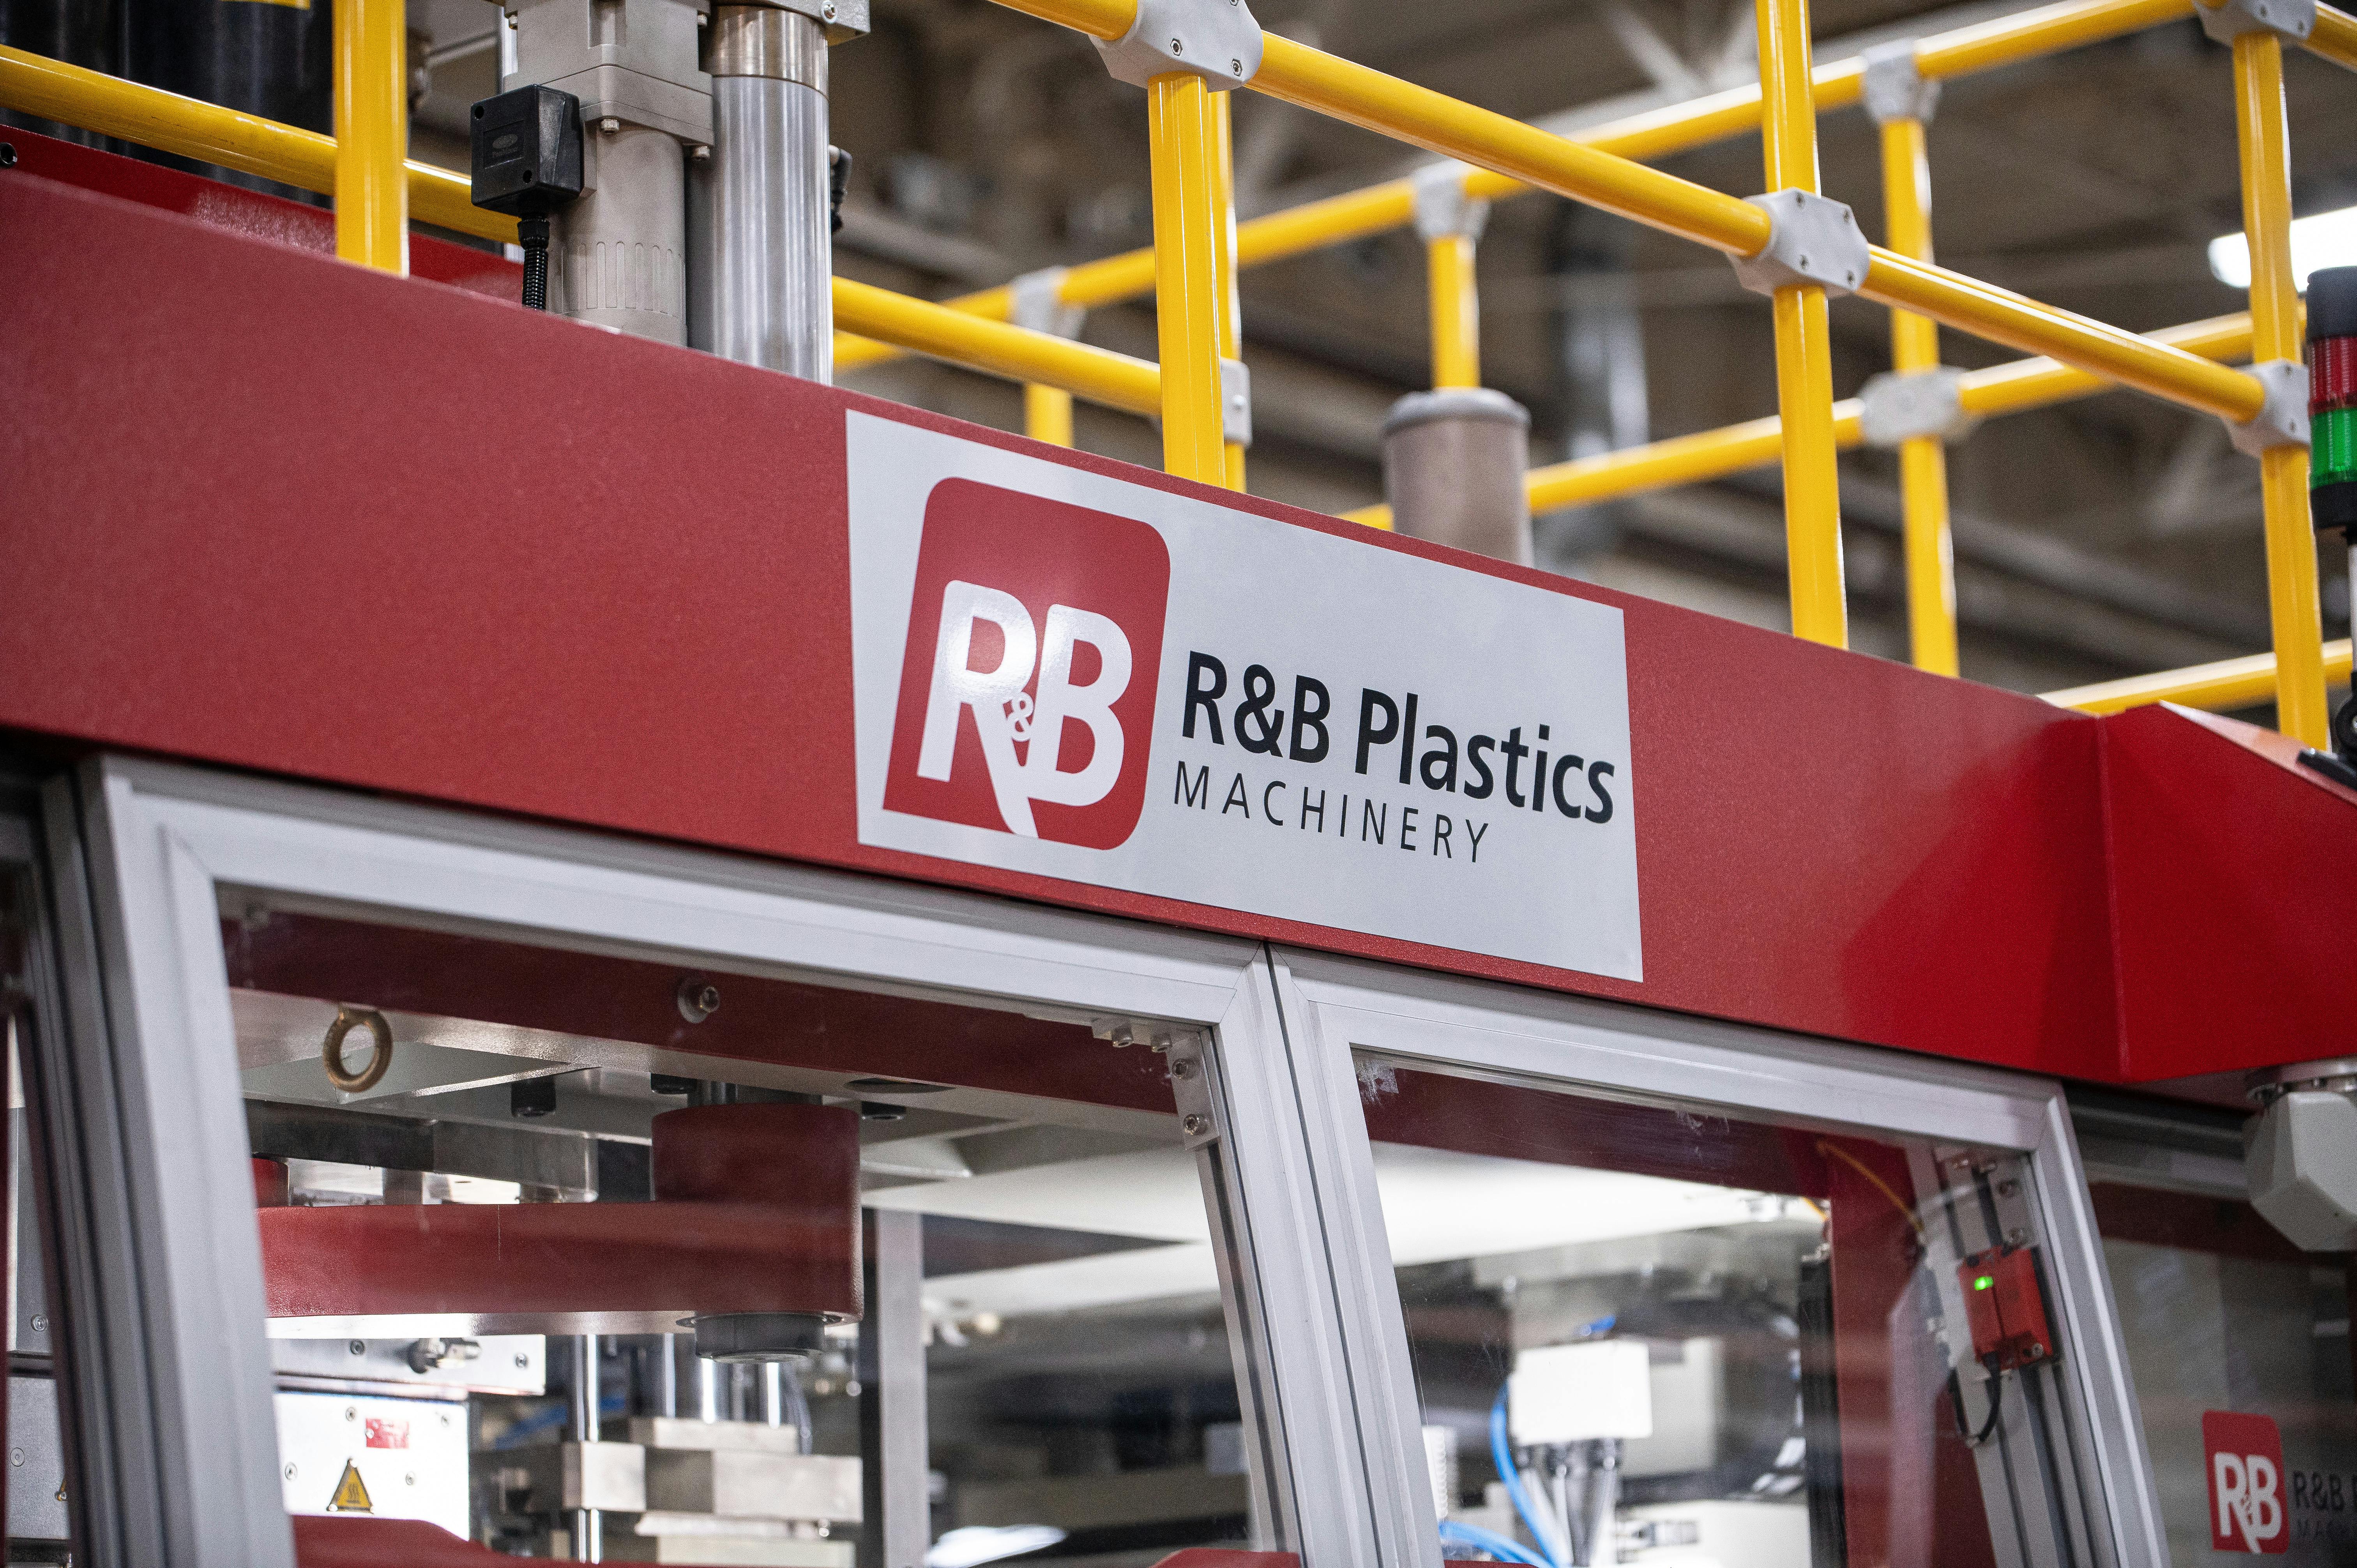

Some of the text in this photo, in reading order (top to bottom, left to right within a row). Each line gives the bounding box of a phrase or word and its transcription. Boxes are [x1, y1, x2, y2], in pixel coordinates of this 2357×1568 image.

[917, 579, 1133, 838] R&B
[1182, 651, 1614, 824] R&B Plastics
[1174, 761, 1488, 862] MACHINERY
[2293, 1470, 2345, 1512] R&B
